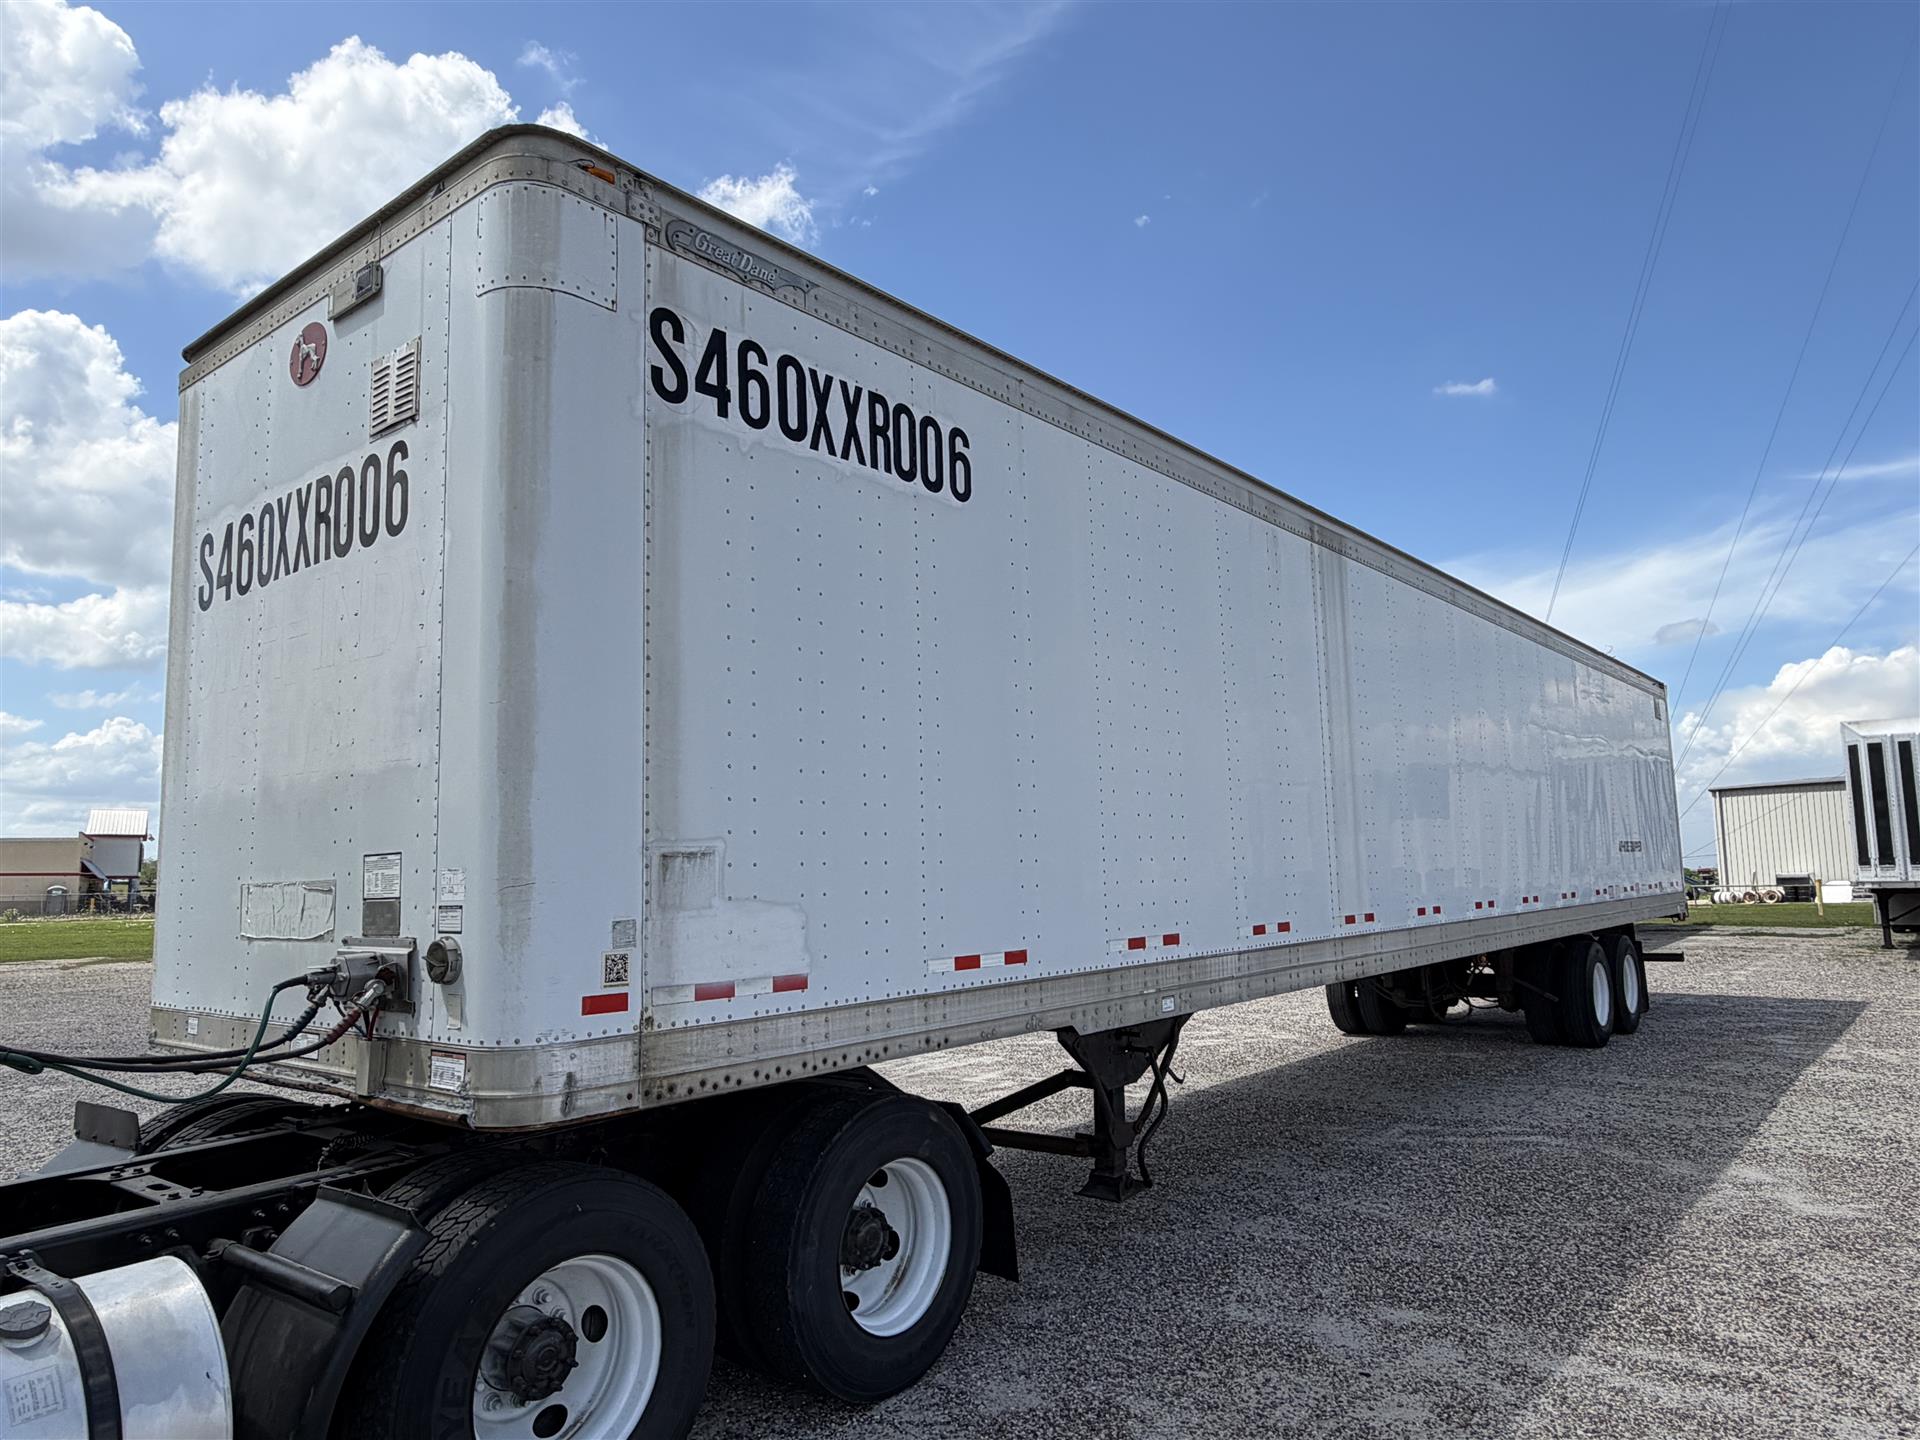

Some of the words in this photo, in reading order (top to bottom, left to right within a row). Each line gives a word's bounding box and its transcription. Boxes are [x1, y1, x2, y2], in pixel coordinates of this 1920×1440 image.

[694, 231, 739, 267] Great
[739, 253, 776, 282] Dane
[649, 307, 972, 503] S460XXR006
[198, 440, 409, 612] S460XXR006
